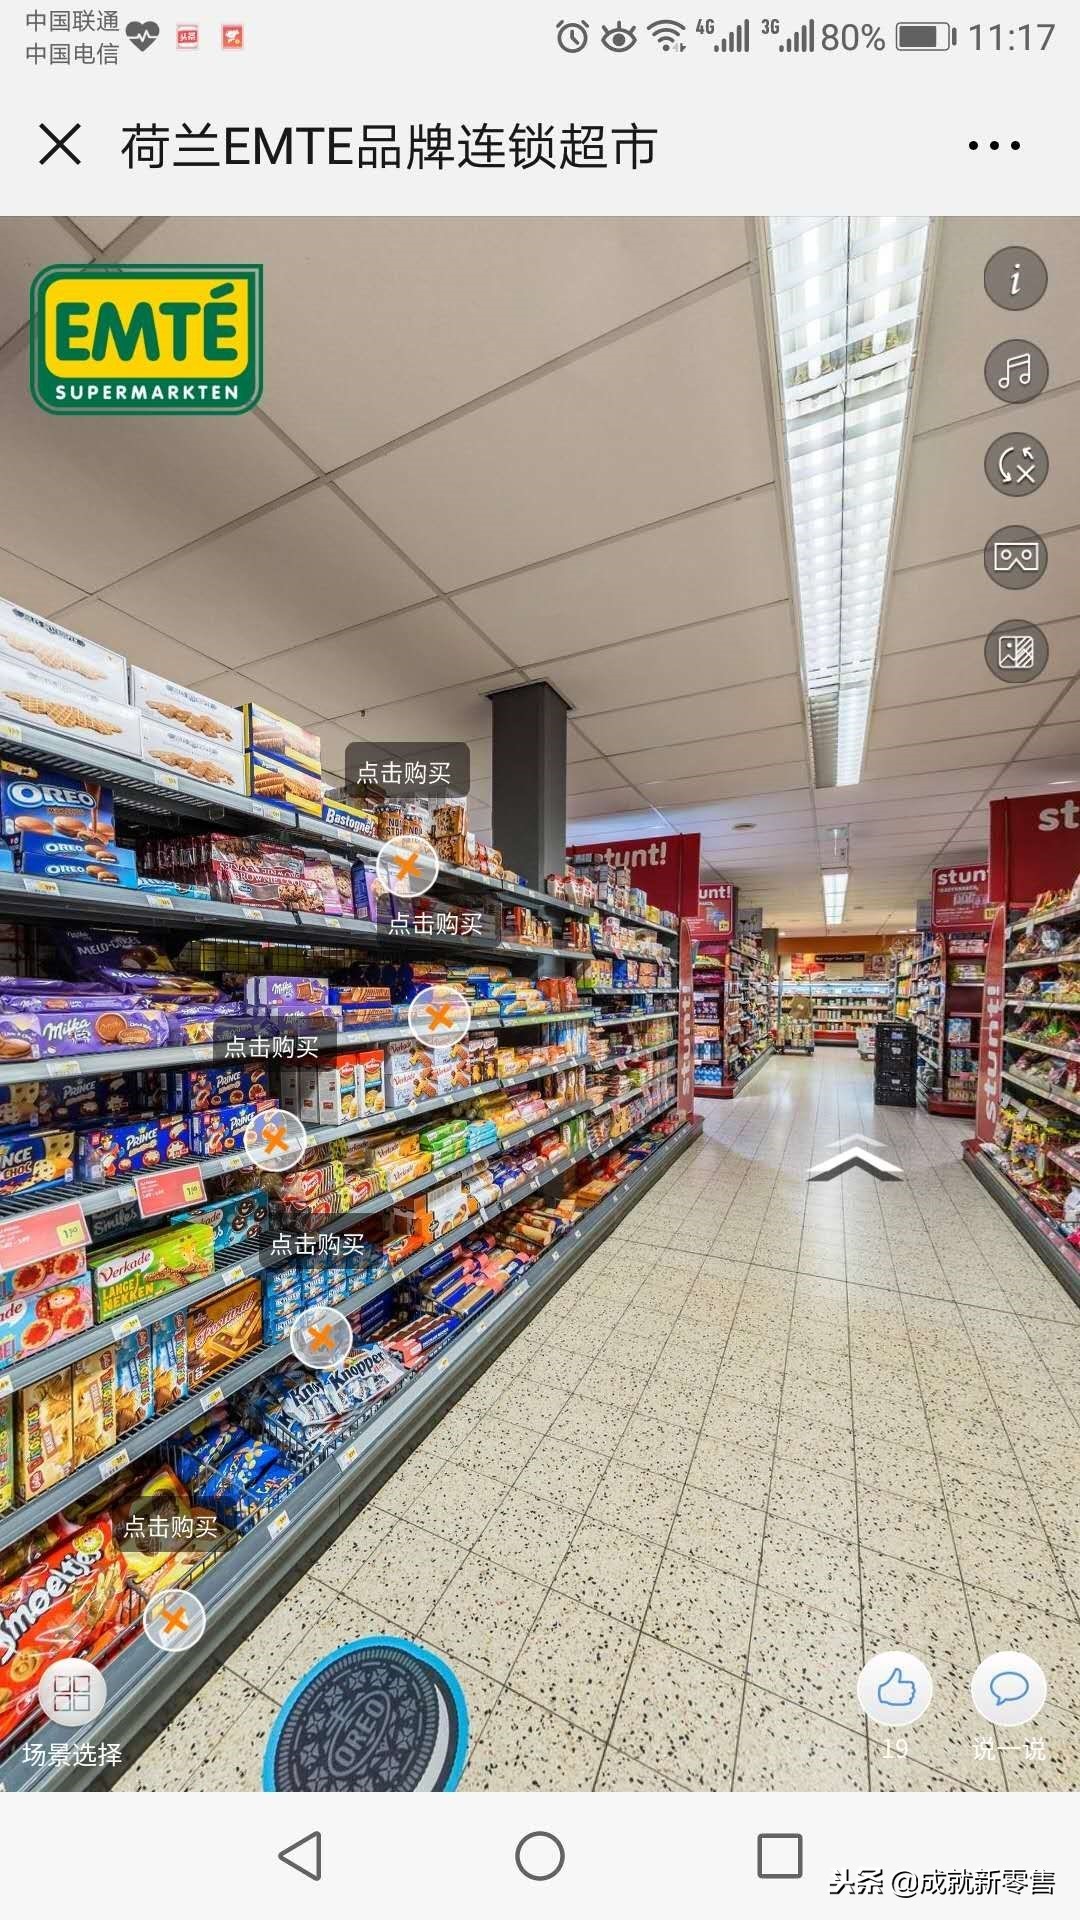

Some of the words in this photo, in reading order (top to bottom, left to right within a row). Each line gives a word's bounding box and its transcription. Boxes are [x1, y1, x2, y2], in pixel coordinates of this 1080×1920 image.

[26, 9, 120, 33] 中国联通
[695, 19, 716, 35] 4G
[761, 19, 781, 35] 3G
[821, 23, 886, 51] 80%
[968, 23, 1056, 51] 11:17
[26, 42, 120, 65] 中国电信
[121, 122, 658, 172] 荷兰EMTE品牌连锁超市
[9, 782, 96, 807] OREO
[937, 869, 989, 885] stun
[43, 1017, 91, 1041] Milka
[63, 1080, 97, 1099] PRINCE
[216, 1071, 241, 1089] PRINCE
[126, 1127, 158, 1151] PRINCE
[3, 1160, 32, 1180] CHOC
[100, 1251, 151, 1282] Verkade
[103, 1282, 154, 1312] NEKKEN
[334, 1698, 386, 1769] OREO
